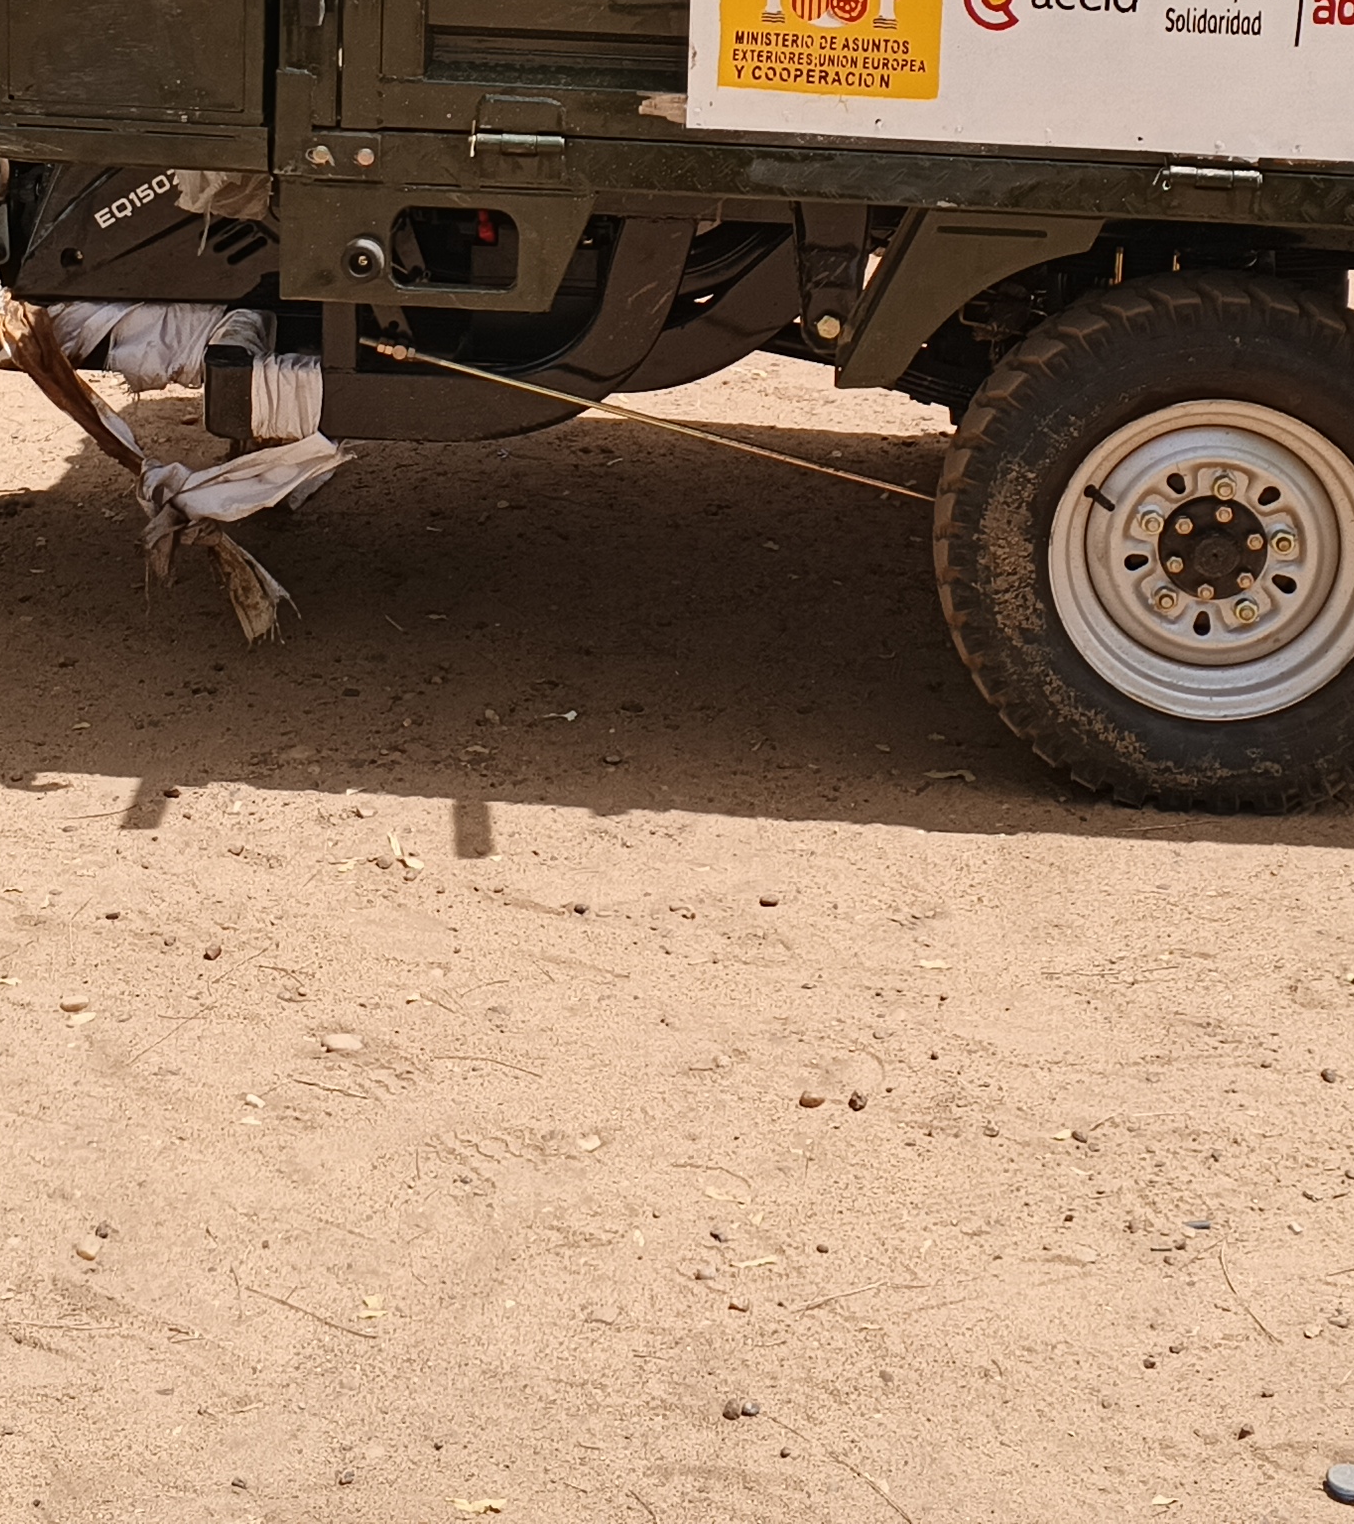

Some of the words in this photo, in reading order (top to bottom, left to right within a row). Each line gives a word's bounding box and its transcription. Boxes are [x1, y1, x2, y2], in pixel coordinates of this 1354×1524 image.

[1165, 7, 1262, 36] Solidaridad
[735, 31, 814, 49] MINISTERIO
[820, 36, 837, 51] DE
[841, 37, 910, 55] ASUNTOS
[734, 65, 744, 79] Y
[751, 65, 891, 89] COOPERACION
[862, 57, 926, 73] EUROPEA
